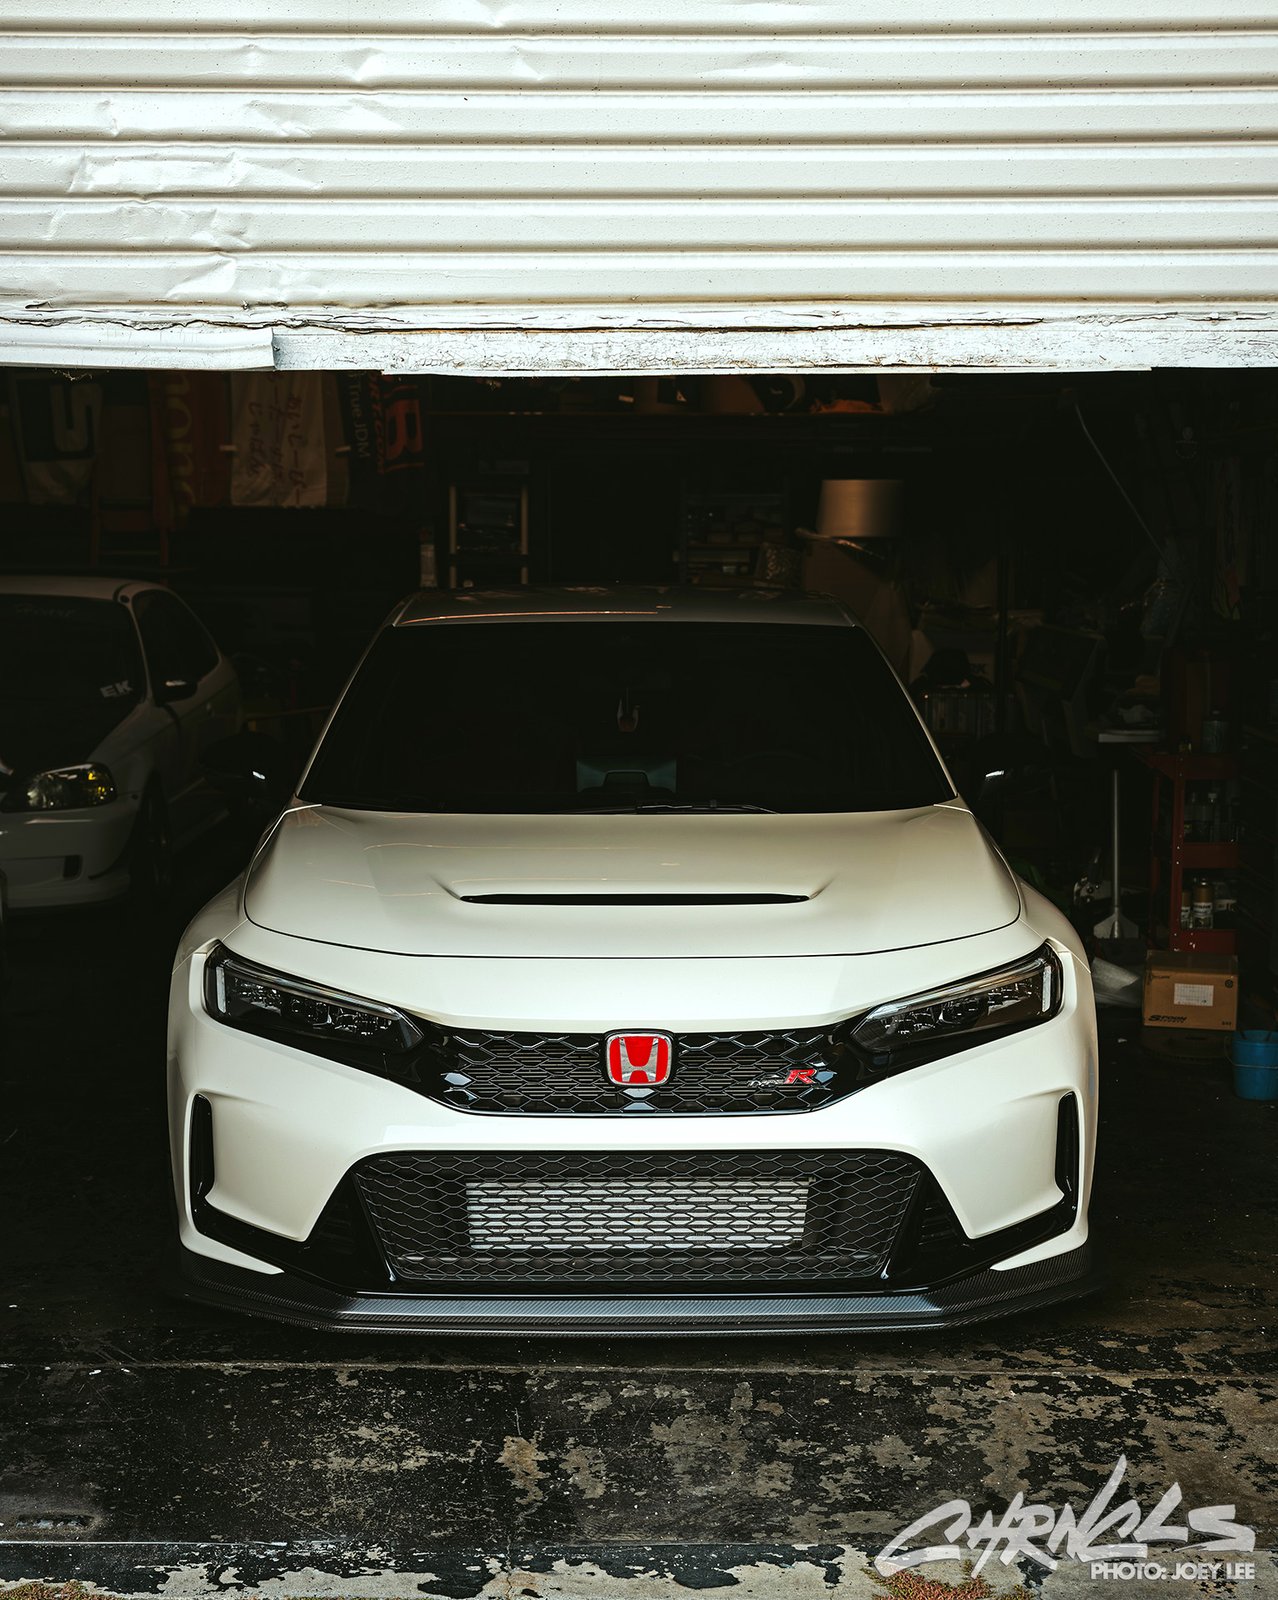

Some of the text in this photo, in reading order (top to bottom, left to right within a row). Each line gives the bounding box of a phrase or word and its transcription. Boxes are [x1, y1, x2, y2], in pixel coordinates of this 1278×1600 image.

[348, 382, 363, 417] True
[353, 422, 371, 458] JDM
[99, 679, 135, 699] EK
[783, 1069, 817, 1085] R
